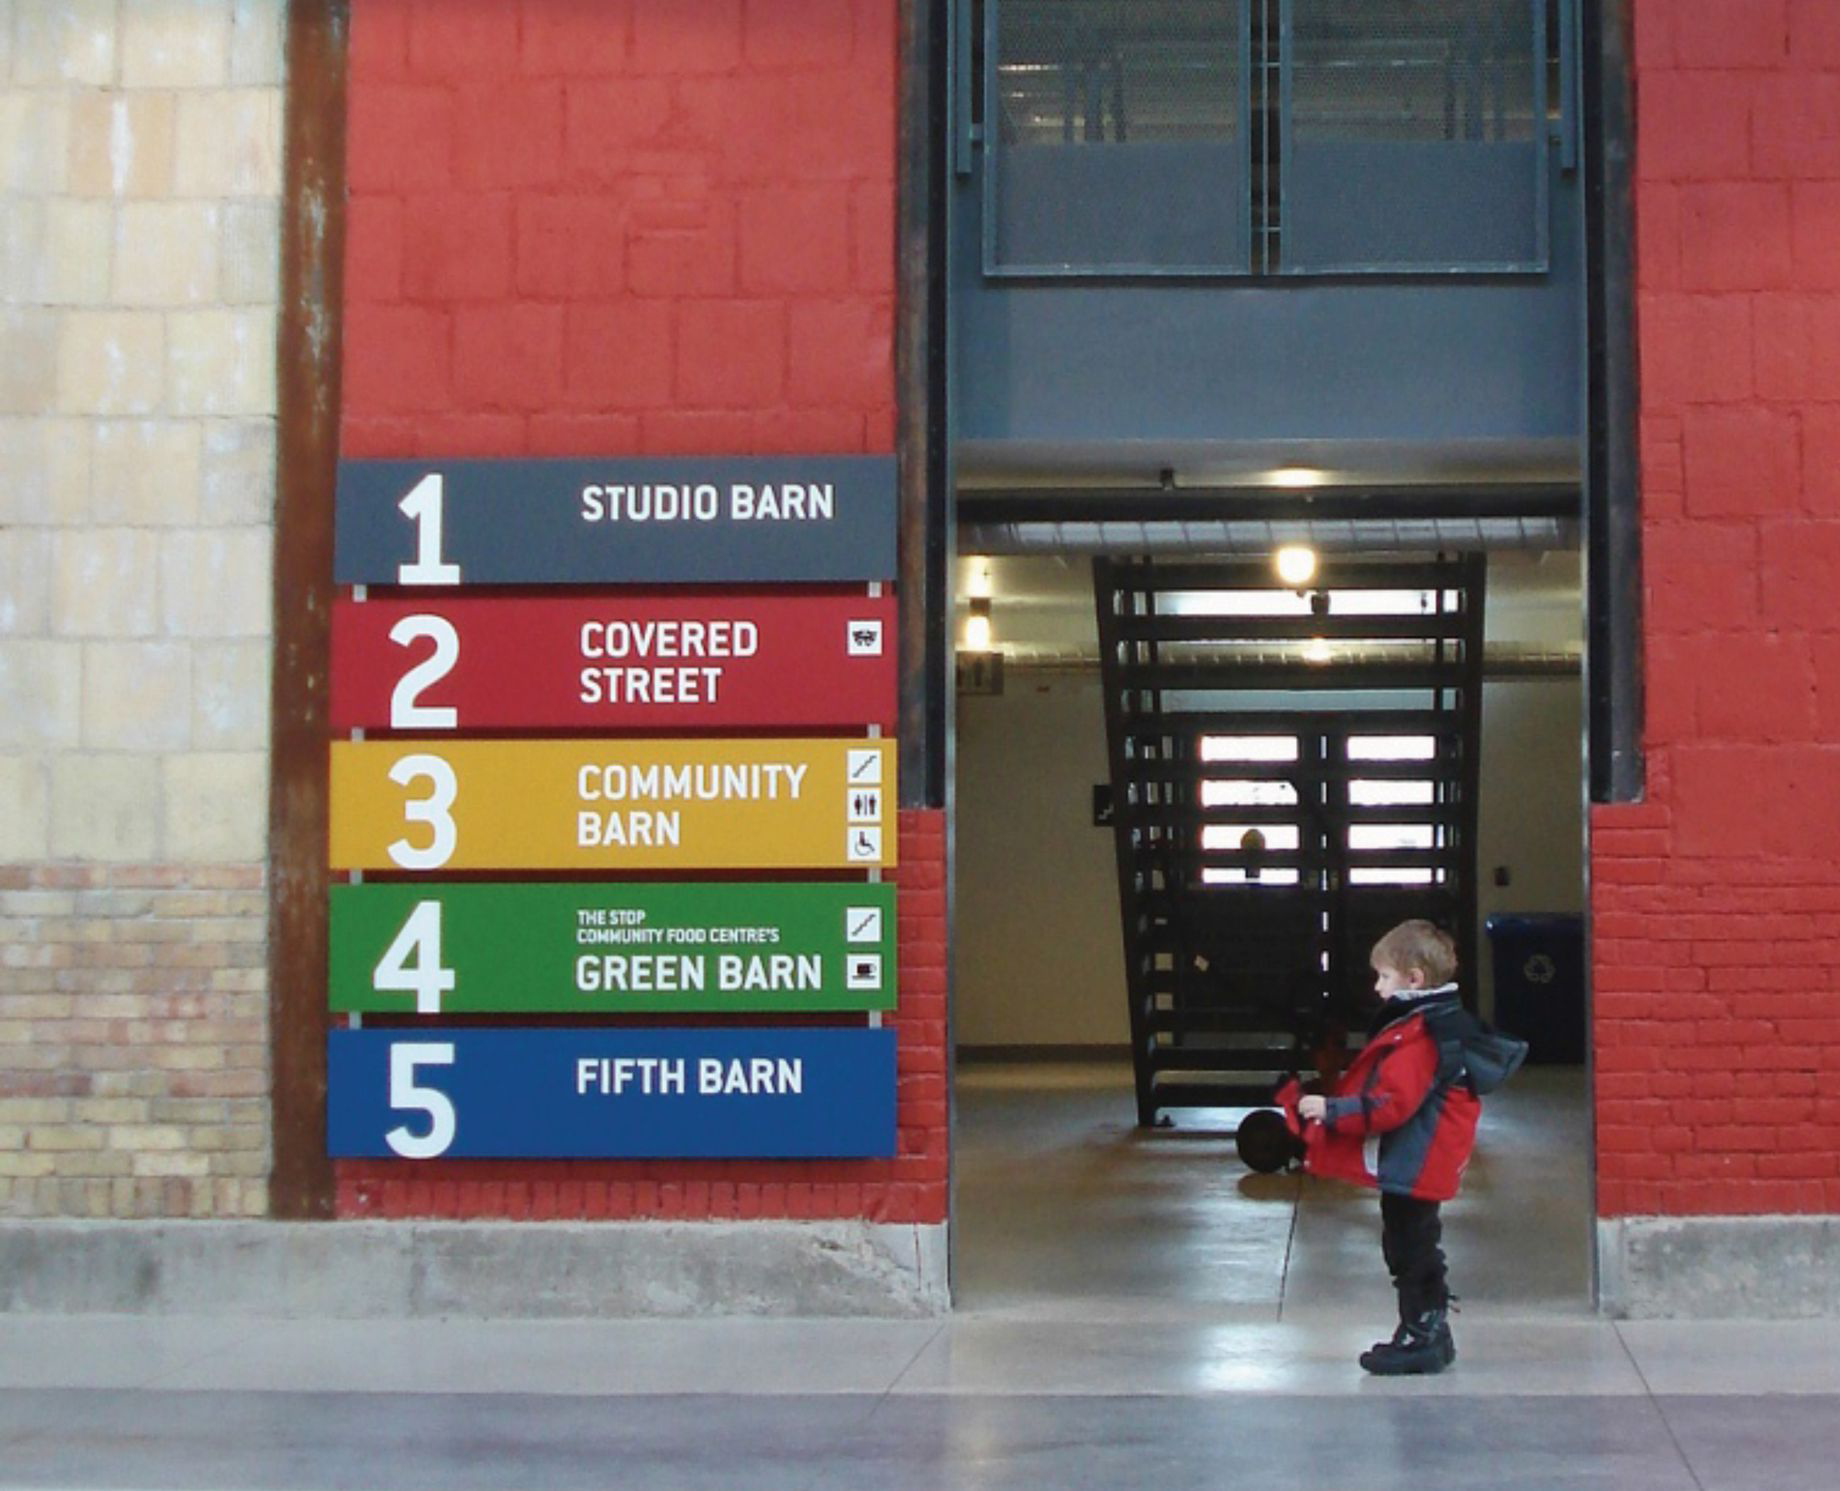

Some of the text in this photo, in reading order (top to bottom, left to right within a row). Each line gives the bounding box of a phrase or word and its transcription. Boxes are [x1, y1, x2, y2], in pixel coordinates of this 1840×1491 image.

[581, 484, 834, 521] STUDIO BARN
[398, 473, 461, 585] 1
[580, 621, 758, 658] COVERED
[388, 614, 460, 729] 2
[580, 667, 722, 703] STREET
[577, 764, 808, 801] COMMUNITY
[386, 754, 458, 869] 3
[577, 811, 681, 847] BARN
[576, 927, 780, 944] COMMUNITY FOOD CENTRE'S
[577, 909, 646, 925] THE STOP
[373, 900, 455, 1013] 4
[576, 955, 822, 991] GREEN BARN
[577, 1059, 803, 1094] FIFTH BARN
[385, 1043, 455, 1159] 5
